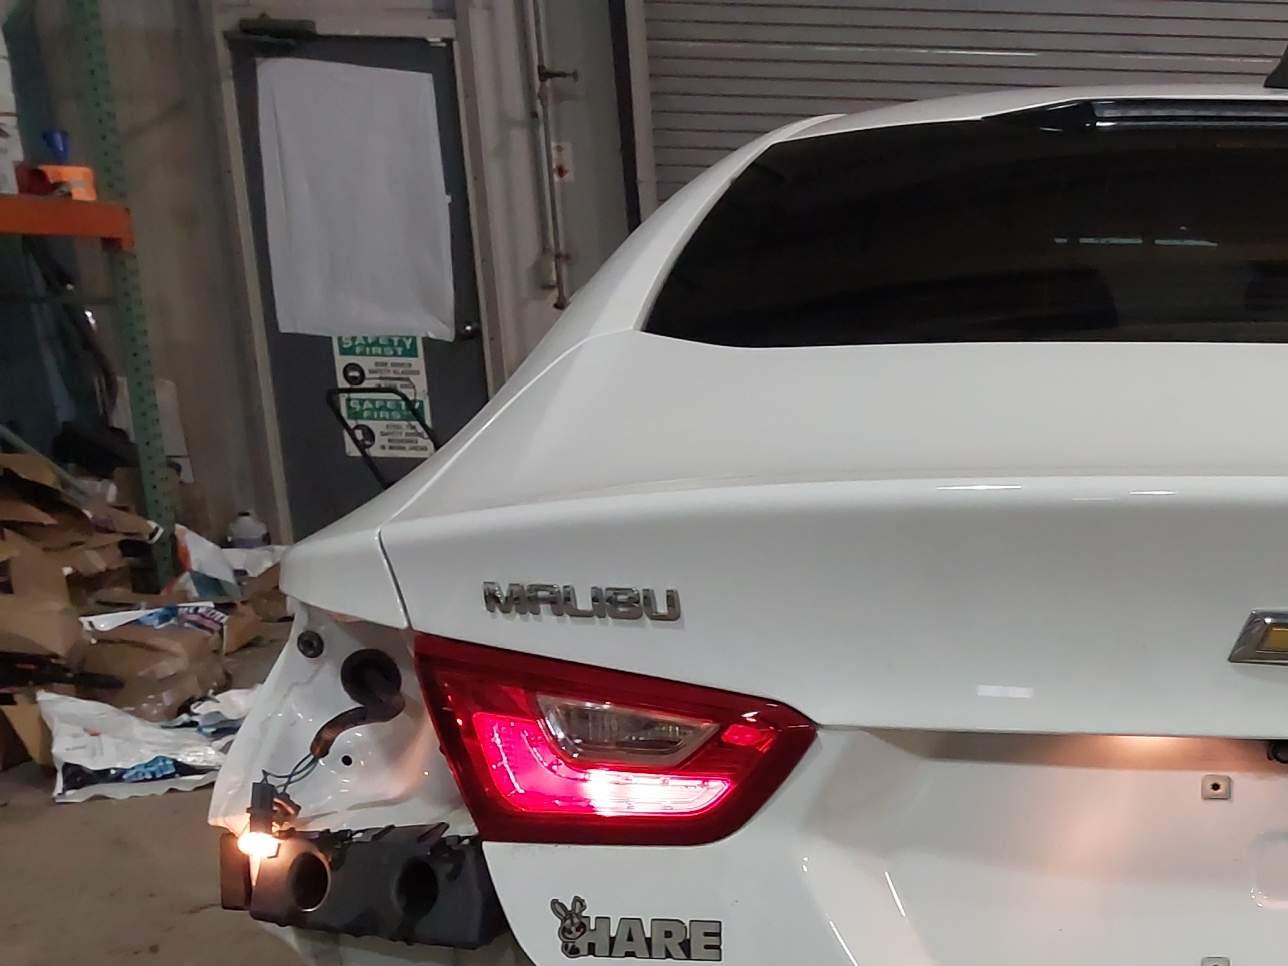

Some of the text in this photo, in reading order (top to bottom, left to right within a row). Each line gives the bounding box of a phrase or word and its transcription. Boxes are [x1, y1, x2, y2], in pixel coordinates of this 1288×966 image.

[342, 336, 414, 349] SAFETY
[355, 346, 404, 356] FIRST
[363, 410, 412, 419] FIRS
[482, 581, 682, 621] MALIBU
[579, 915, 722, 962] HARE
